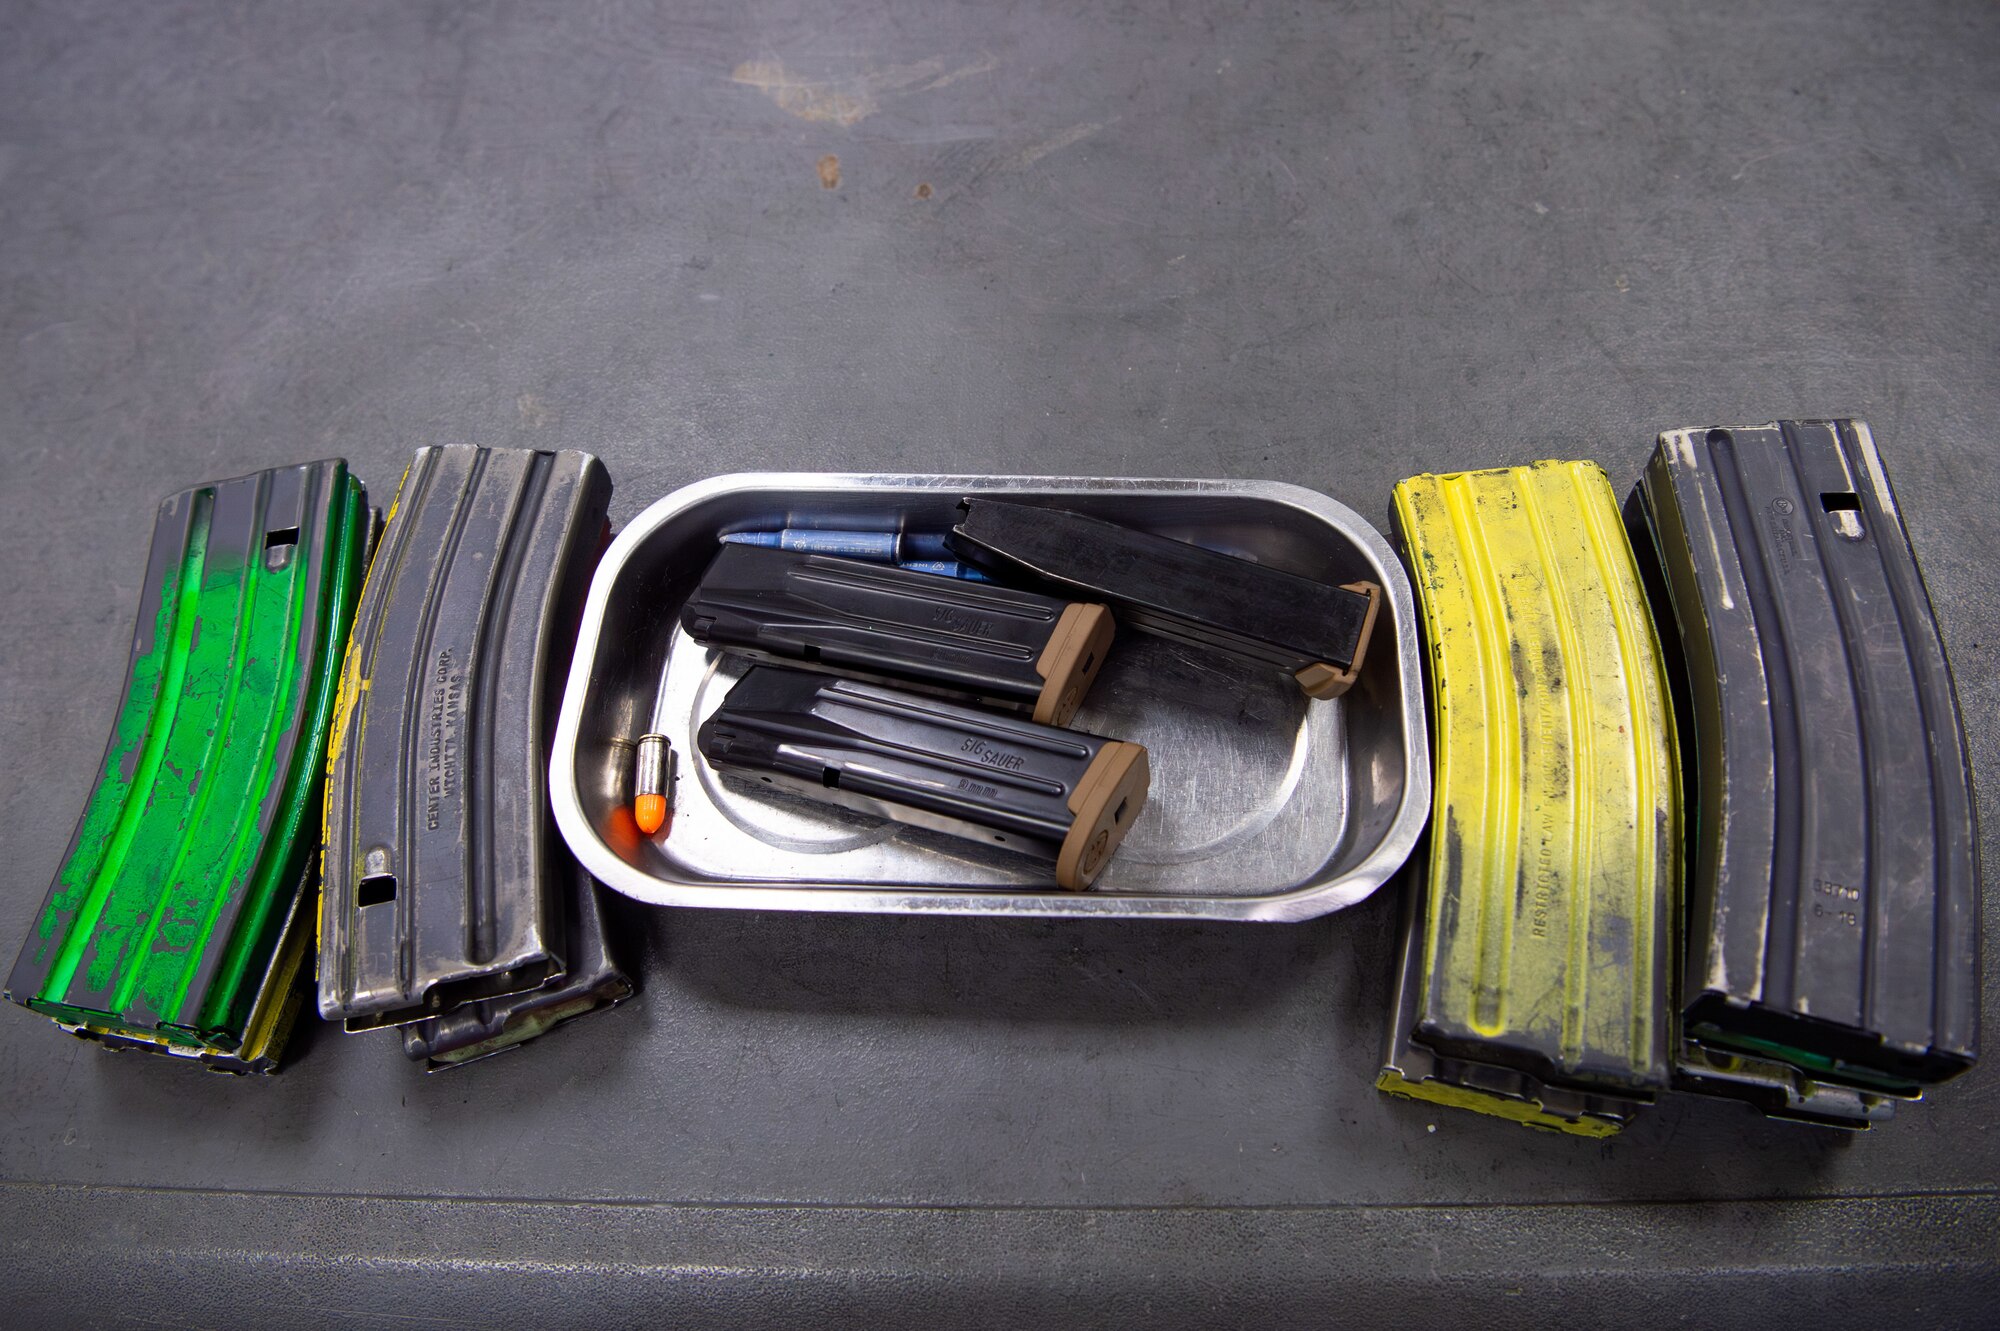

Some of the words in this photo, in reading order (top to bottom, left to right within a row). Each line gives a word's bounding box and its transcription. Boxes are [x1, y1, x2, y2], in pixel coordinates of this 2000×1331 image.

[932, 606, 956, 624] SIG
[952, 615, 994, 638] SAUER
[436, 648, 452, 684] CORP.
[446, 674, 462, 728] KANSAS
[429, 688, 445, 771] INDUSTRIES
[960, 738, 987, 755] SIG
[980, 749, 1025, 771] SAUER
[427, 777, 440, 831] CENTER
[1541, 814, 1553, 842] LAW
[1532, 848, 1552, 937] RESTRICTED
